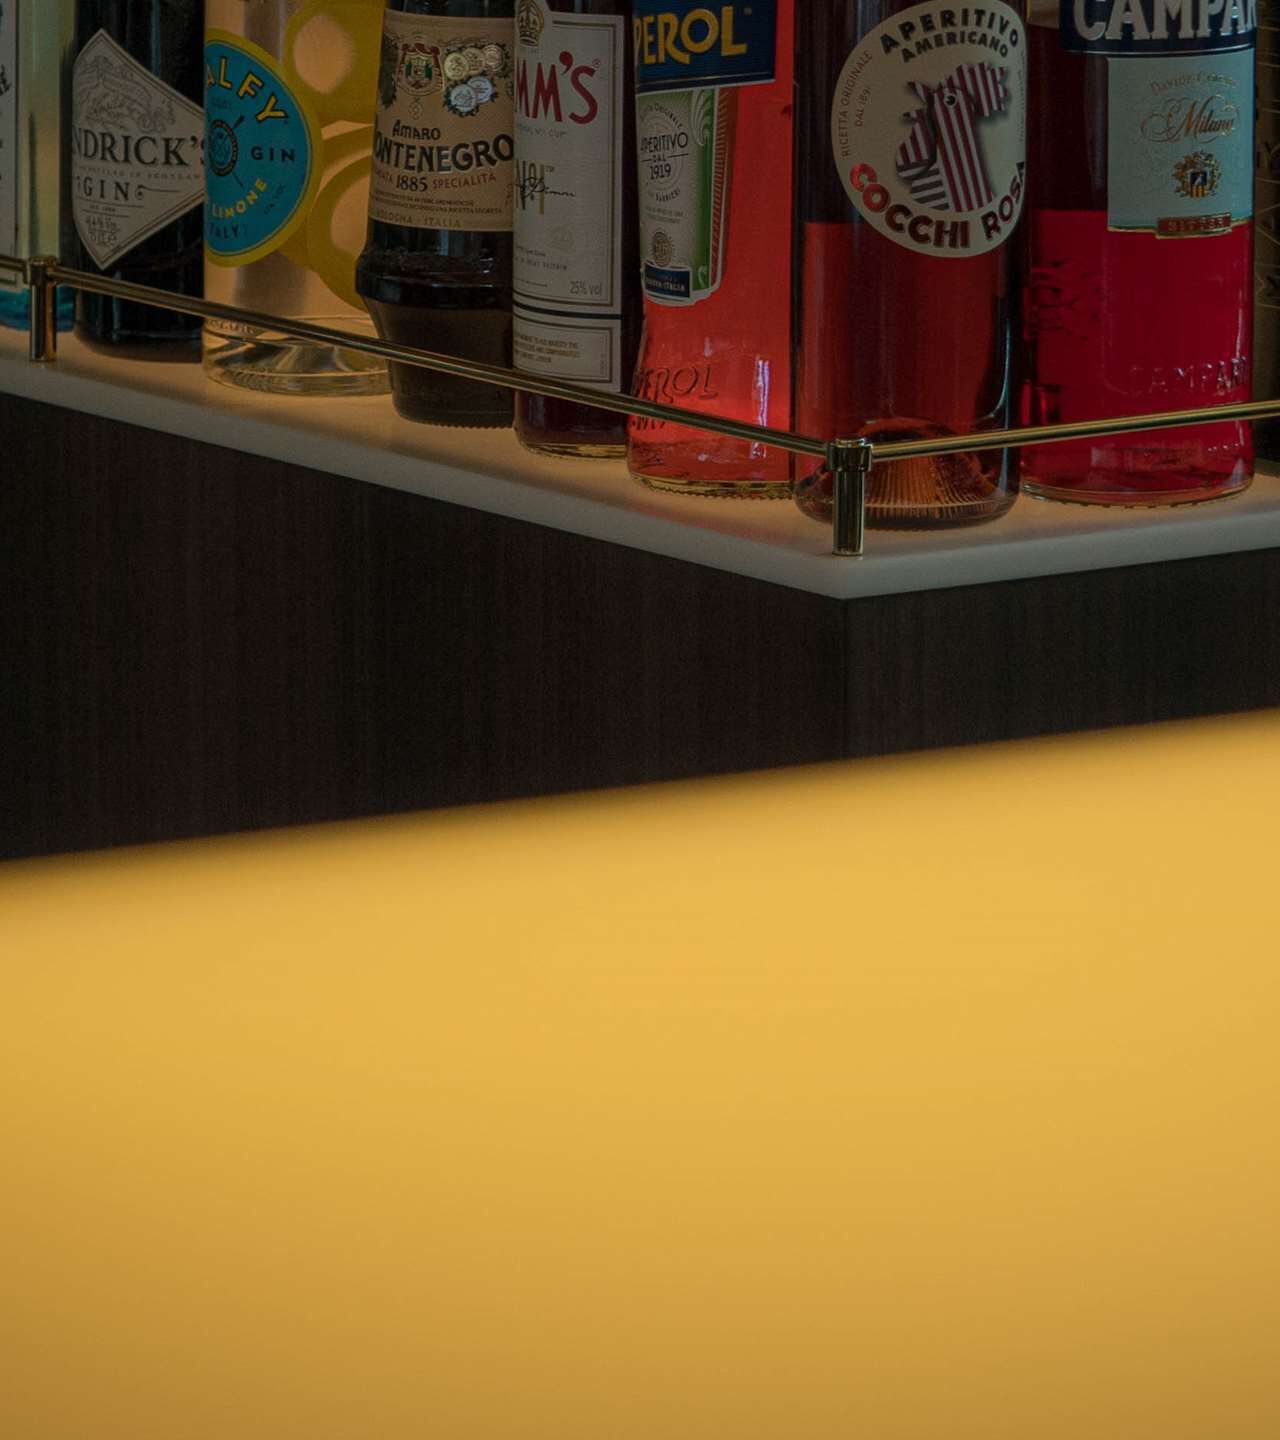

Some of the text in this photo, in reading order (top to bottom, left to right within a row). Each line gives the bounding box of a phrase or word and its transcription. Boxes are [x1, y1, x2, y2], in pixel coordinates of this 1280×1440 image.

[633, 6, 748, 66] PEROL
[880, 8, 1018, 54] APERITIVO
[901, 30, 1009, 63] AMERICANO
[207, 57, 288, 123] ALFY
[517, 50, 599, 125] MM'S
[841, 49, 873, 105] ORIGINALE
[72, 127, 205, 167] NDRICK'
[392, 119, 442, 141] AMARO
[250, 145, 296, 164] GIN
[374, 131, 515, 174] ONTENEGRO
[649, 163, 672, 181] 1919
[83, 176, 130, 201] GIN
[395, 174, 428, 192] 1885
[849, 162, 970, 248] COCCHI
